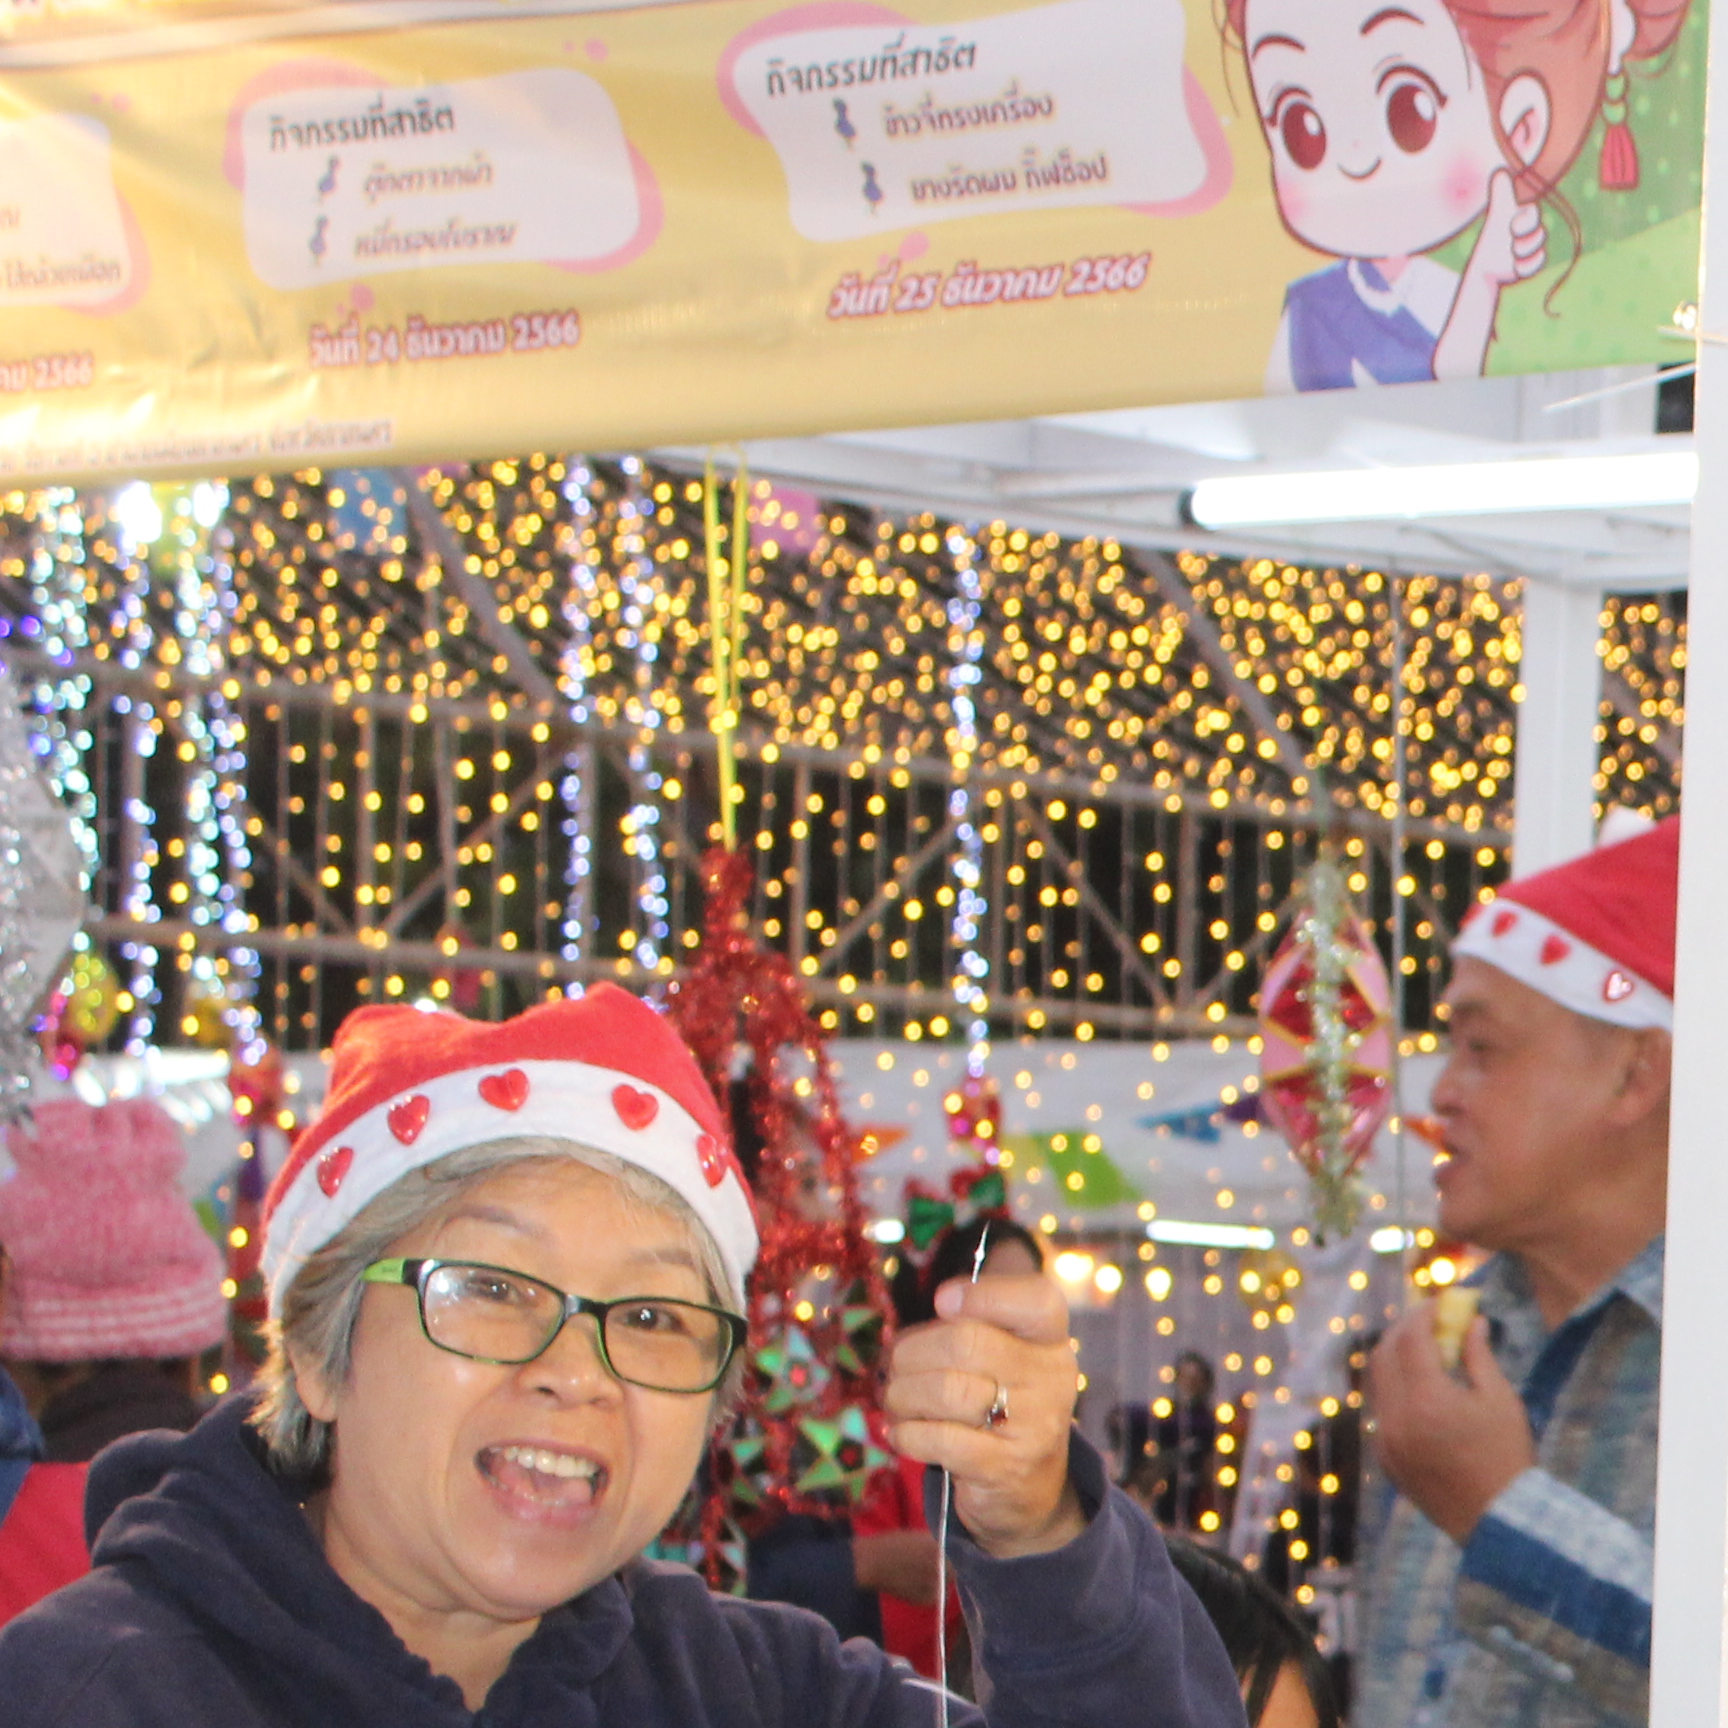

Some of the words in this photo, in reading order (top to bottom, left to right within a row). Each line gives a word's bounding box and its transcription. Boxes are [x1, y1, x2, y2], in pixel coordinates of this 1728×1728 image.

[766, 33, 977, 96] กิจกรรมที่สาธิต
[268, 94, 456, 150] กิจกรรมที่สาธิต
[828, 261, 901, 317] วันที่
[894, 273, 940, 311] 25
[941, 261, 1064, 307] ธันวาคม
[1063, 252, 1150, 295] 2566
[310, 312, 360, 367] วันที่
[365, 327, 399, 364] 24
[509, 309, 580, 351] 2566
